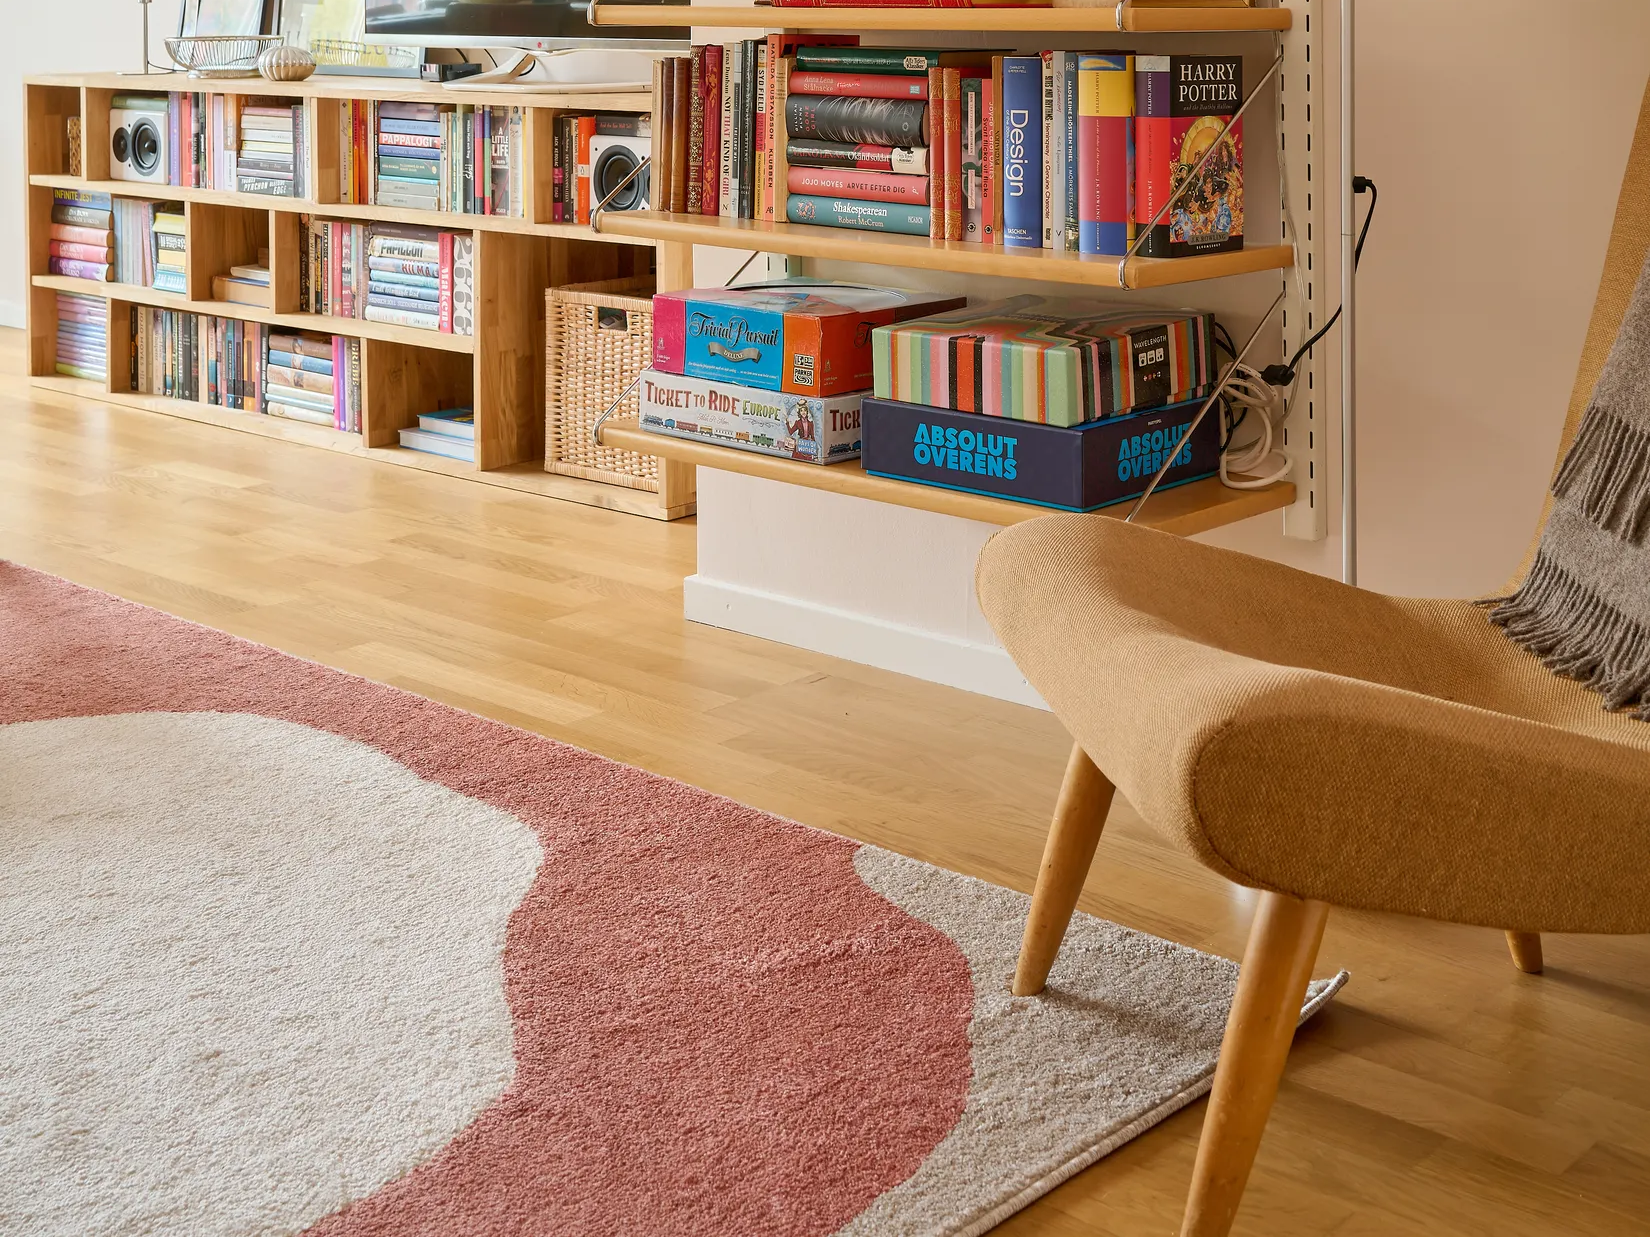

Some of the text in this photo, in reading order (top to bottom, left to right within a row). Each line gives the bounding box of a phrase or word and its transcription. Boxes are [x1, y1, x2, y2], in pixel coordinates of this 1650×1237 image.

[1179, 63, 1237, 83] HARRY
[1179, 83, 1238, 103] POTTER
[381, 133, 433, 148] PAPPALOGI
[491, 126, 508, 157] A LITTLE LIFE
[723, 139, 731, 162] KIND
[1005, 109, 1029, 197] Design
[723, 164, 730, 177] OF
[54, 189, 93, 202] INFINITE JEST
[243, 182, 287, 195] PYNCHON EDGE
[722, 177, 730, 197] GIRL
[801, 178, 819, 186] JOJO
[820, 179, 844, 188] MOYES
[870, 184, 891, 193] EFTER
[892, 186, 906, 194] DIG
[832, 201, 888, 219] Shakespearean
[837, 215, 884, 228] Robert McCrum
[687, 311, 779, 348] Trivial Pursuit
[1133, 334, 1167, 350] WAVELENGTH
[794, 367, 813, 377] PARKER
[644, 380, 782, 422] TICKET TO RIDE EUROPE
[830, 408, 861, 432] TICK
[913, 423, 1018, 460] ABSOLUT
[913, 443, 1018, 482] OVERENS
